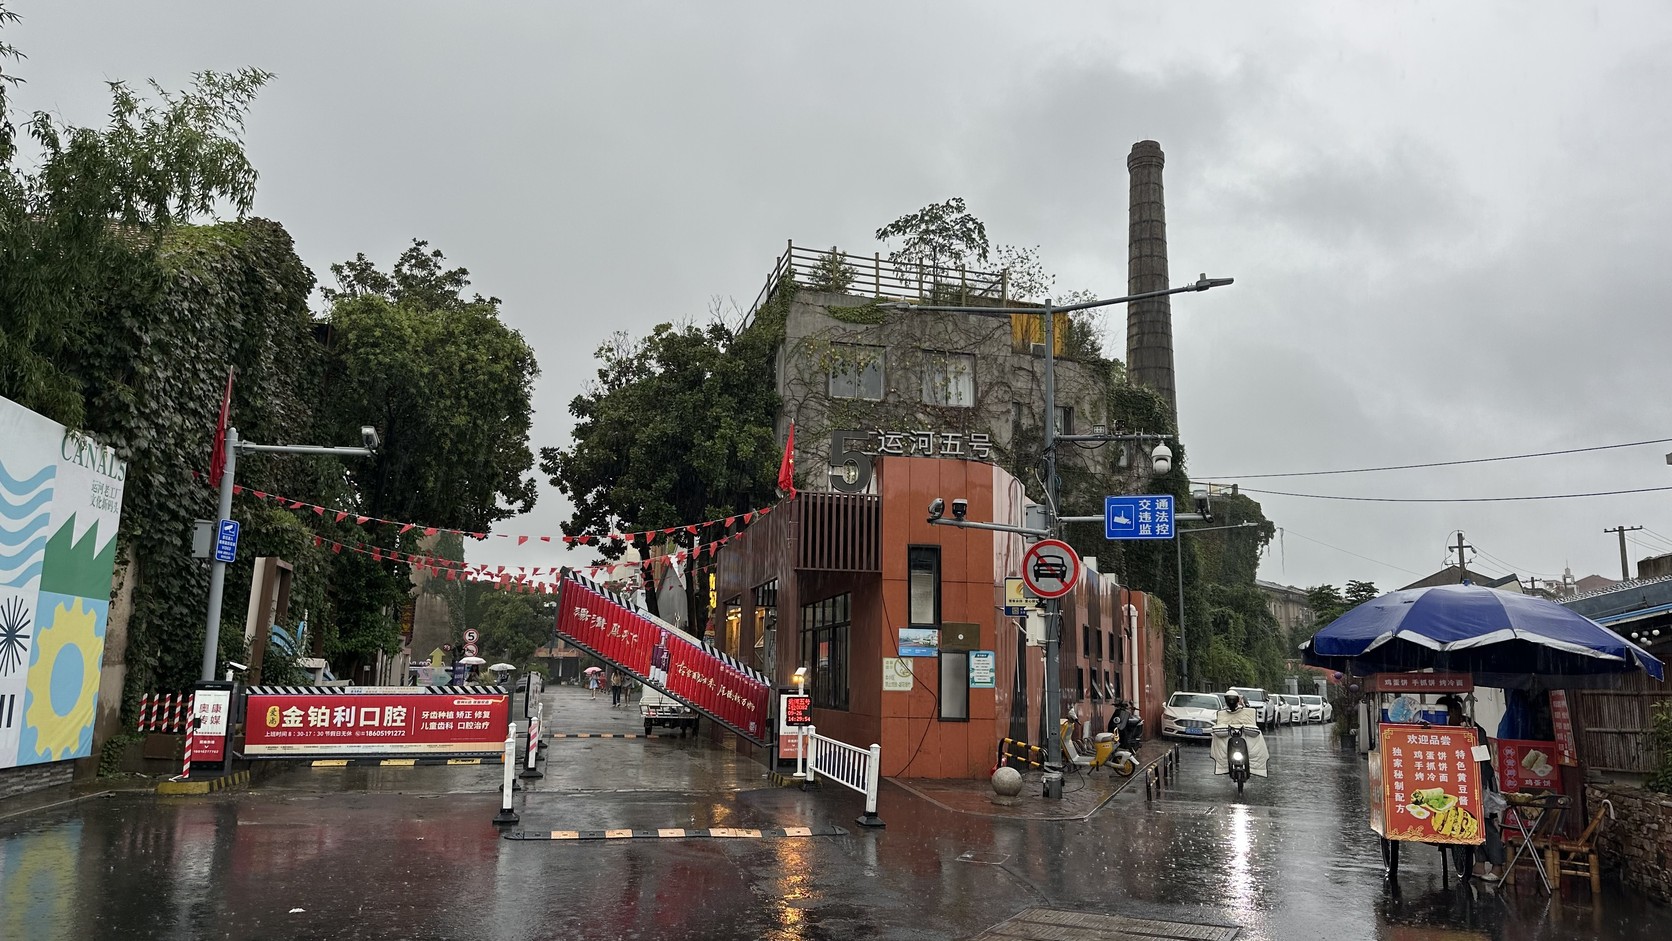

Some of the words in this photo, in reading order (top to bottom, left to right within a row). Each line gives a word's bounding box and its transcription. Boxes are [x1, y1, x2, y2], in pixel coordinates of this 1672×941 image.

[876, 429, 993, 459] 运河五号
[830, 429, 872, 493] 5
[91, 480, 121, 499] 运河老工厂
[90, 494, 119, 514] 文化新码头
[1138, 499, 1169, 511] 交通
[1138, 511, 1169, 523] 违法
[1138, 523, 1170, 535] 监控
[468, 632, 474, 640] 5
[1411, 679, 1436, 687] 手抓饼
[1440, 679, 1464, 687] 烤冷面
[199, 703, 222, 713] 奥康
[198, 715, 221, 725] 传媒
[281, 705, 407, 728] 金铂利口腔
[421, 711, 454, 720] 牙齿种植
[456, 711, 473, 719] 矫正
[474, 711, 491, 719] 修复
[420, 722, 454, 730] 儿童齿科
[457, 722, 490, 730] 口腔治疗
[1407, 734, 1451, 746] 欢迎品尝
[1413, 750, 1447, 760] 鸡蛋饼
[1414, 761, 1448, 771] 手抓饼
[1392, 747, 1406, 814] 独家秘制配方
[1414, 772, 1449, 782] 烤冷面
[1455, 750, 1468, 806] 特色黄豆酱
